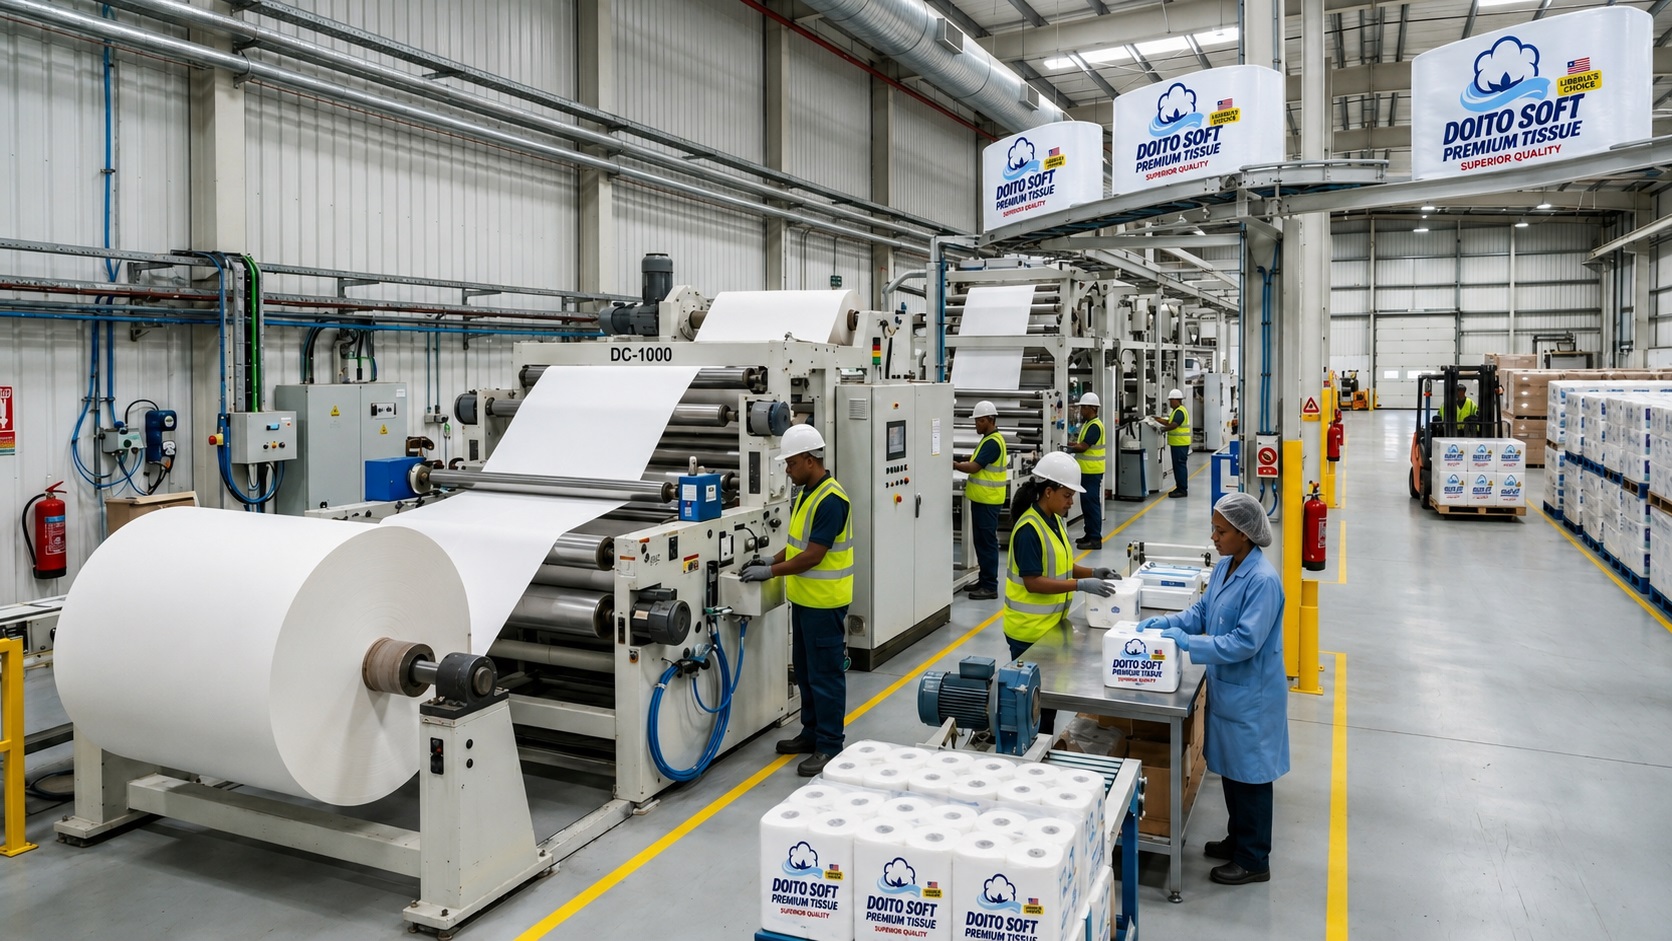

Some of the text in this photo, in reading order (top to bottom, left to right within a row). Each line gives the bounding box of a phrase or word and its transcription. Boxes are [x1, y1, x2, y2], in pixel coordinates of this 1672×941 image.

[1563, 81, 1596, 93] CHOICE
[1443, 93, 1585, 146] DOITO SOFT
[1136, 124, 1224, 161] DOITO SOFT
[1442, 120, 1583, 162] PREMIUM TISSUE
[1135, 142, 1222, 173] PREMIUM TISSUE
[1178, 160, 1209, 174] QUALITY
[1460, 144, 1562, 171] SUPERIOR QUALITY
[996, 168, 1056, 201] DOITO SOFT
[1028, 184, 1055, 201] TISSUE
[610, 347, 672, 362] DC-1000
[1113, 659, 1163, 670] DOITO SOFT
[772, 877, 839, 899] DOITO SOFT
[771, 894, 839, 911] PREMIUM TISSUE
[867, 895, 938, 917] DOITO SOFT
[866, 911, 937, 929] PREMIUM TISSUE
[965, 911, 1039, 934] DOITO SOFT
[965, 927, 1006, 941] PREMIUM
